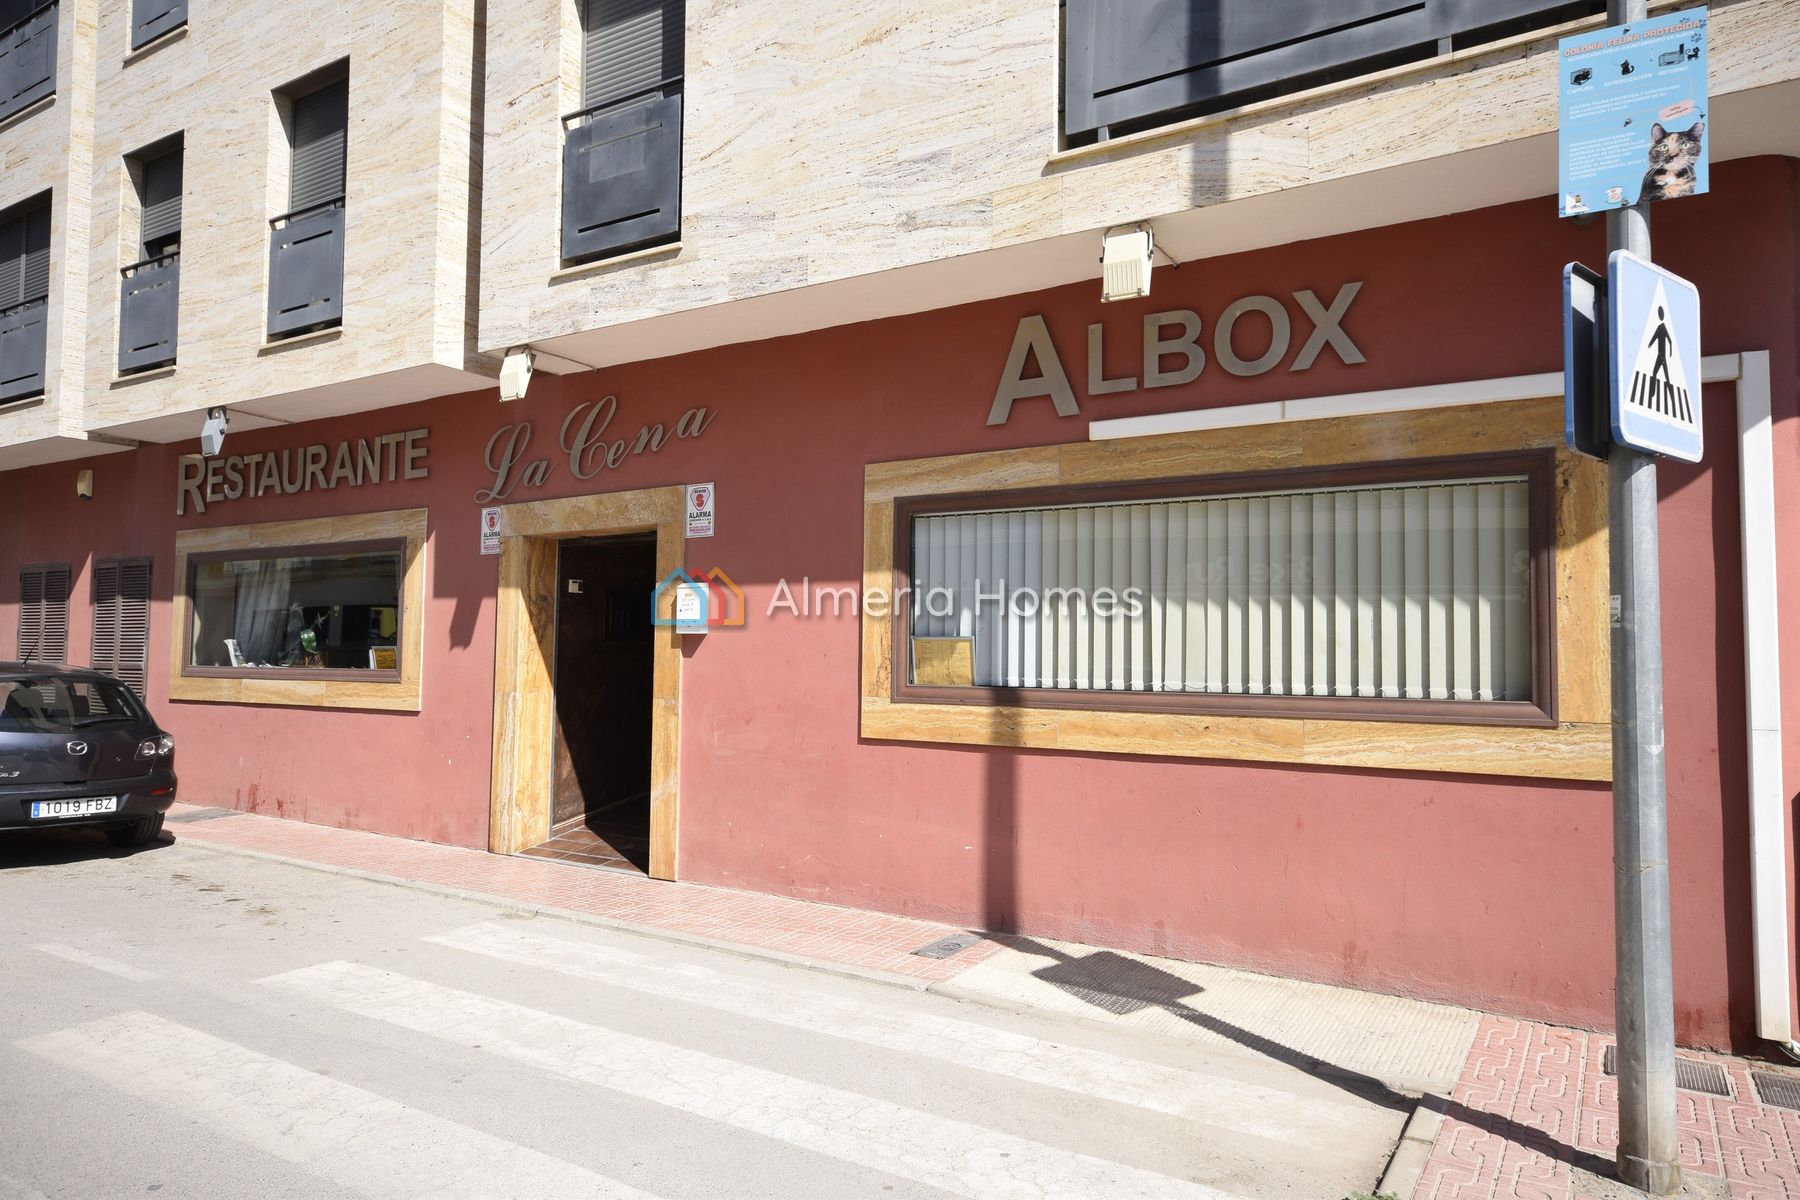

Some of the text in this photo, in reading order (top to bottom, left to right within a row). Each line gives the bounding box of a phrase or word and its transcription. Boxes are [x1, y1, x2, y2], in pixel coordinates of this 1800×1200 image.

[1564, 43, 1604, 57] COLONIA
[1607, 34, 1640, 46] FELINA
[986, 281, 1367, 426] ALBOX
[177, 428, 429, 516] RESTAURANTE
[474, 395, 718, 504] La Cena
[689, 511, 711, 519] ALARMA
[46, 798, 113, 814] 1019 FBZ
